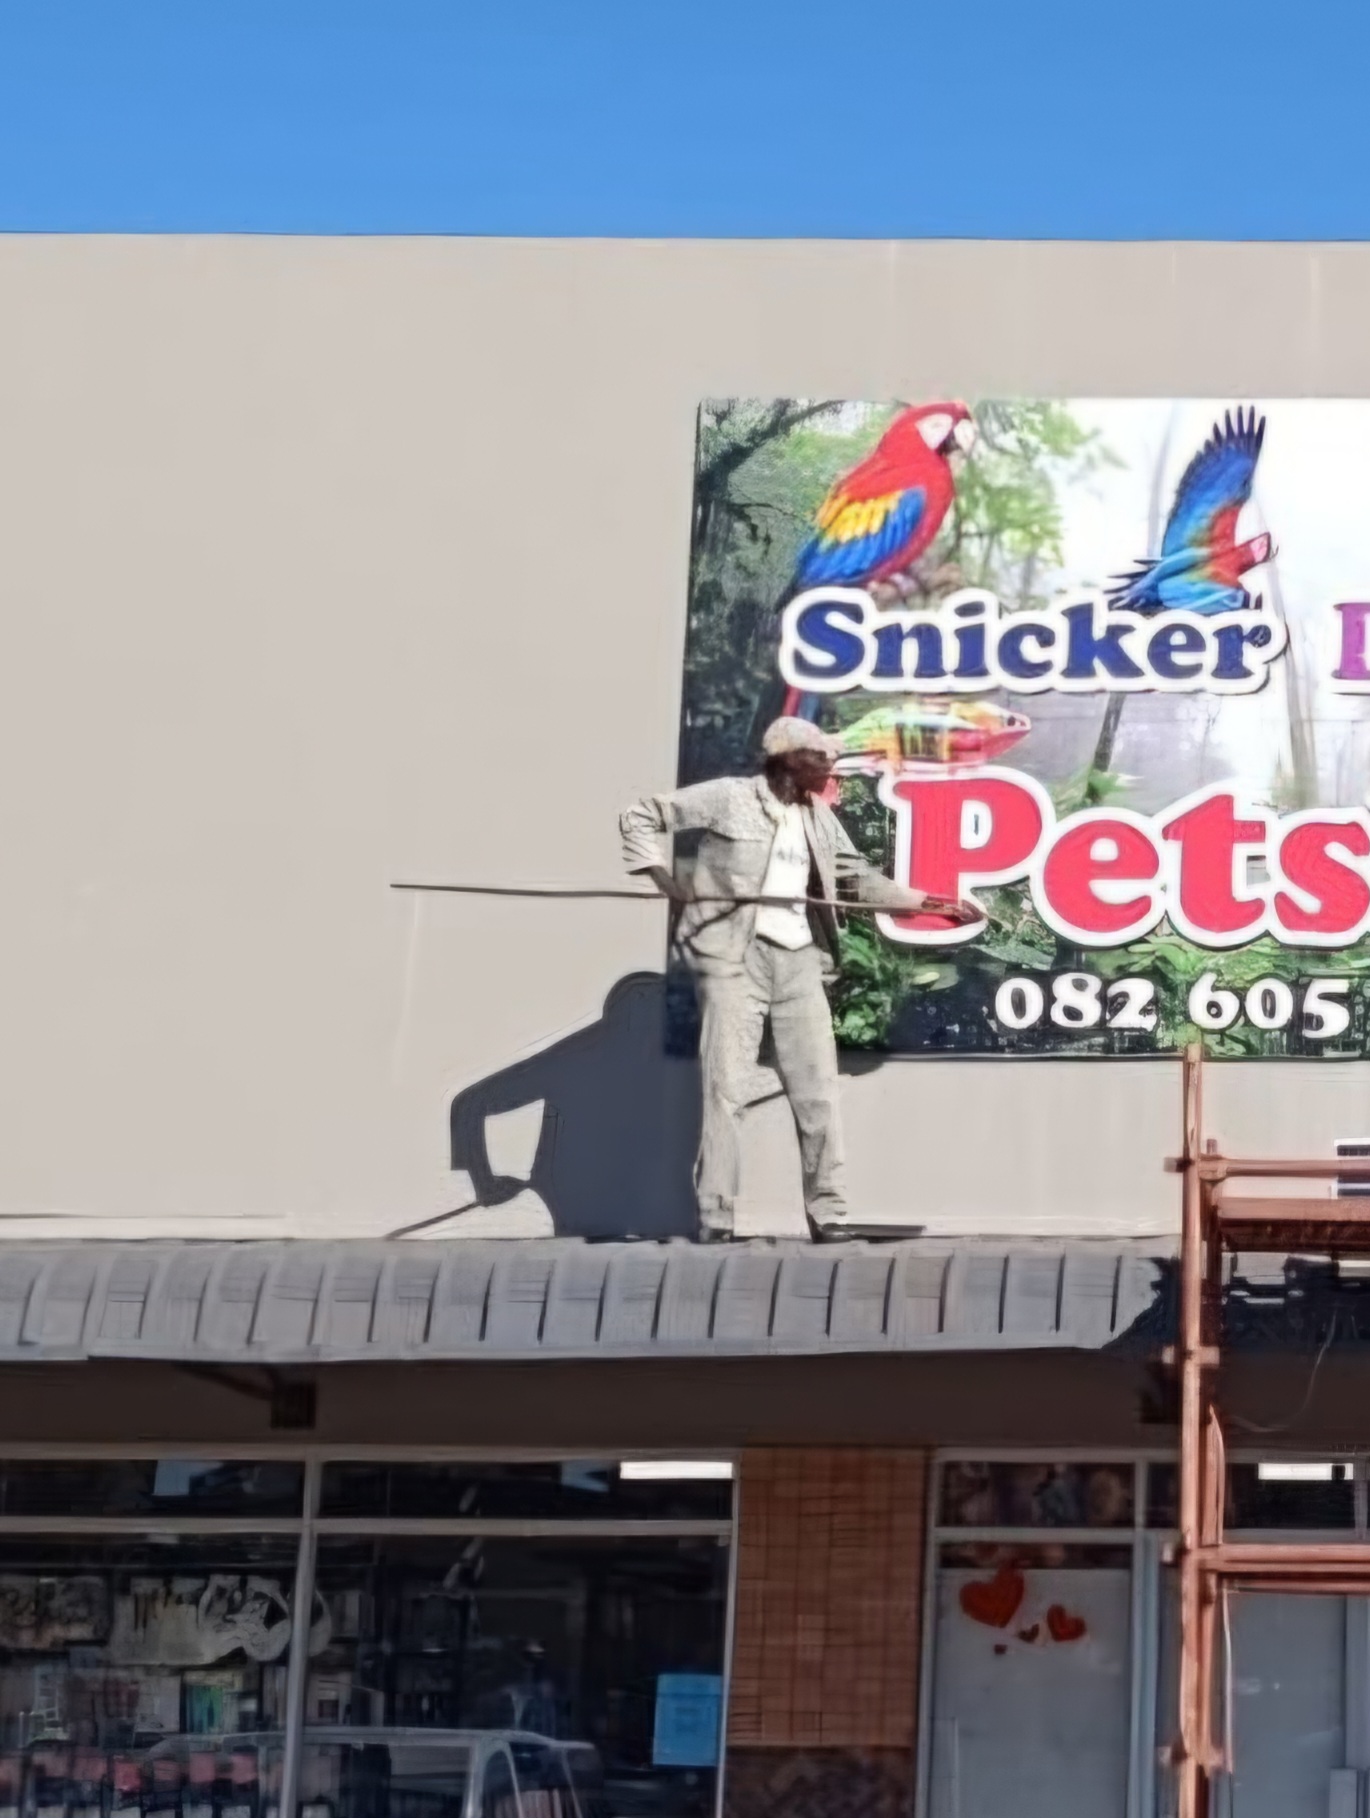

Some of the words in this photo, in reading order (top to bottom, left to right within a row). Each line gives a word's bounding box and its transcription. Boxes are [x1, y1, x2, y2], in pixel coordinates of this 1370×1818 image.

[790, 597, 1273, 682] Snicker
[995, 972, 1158, 1031] 082
[1189, 972, 1350, 1039] 605
